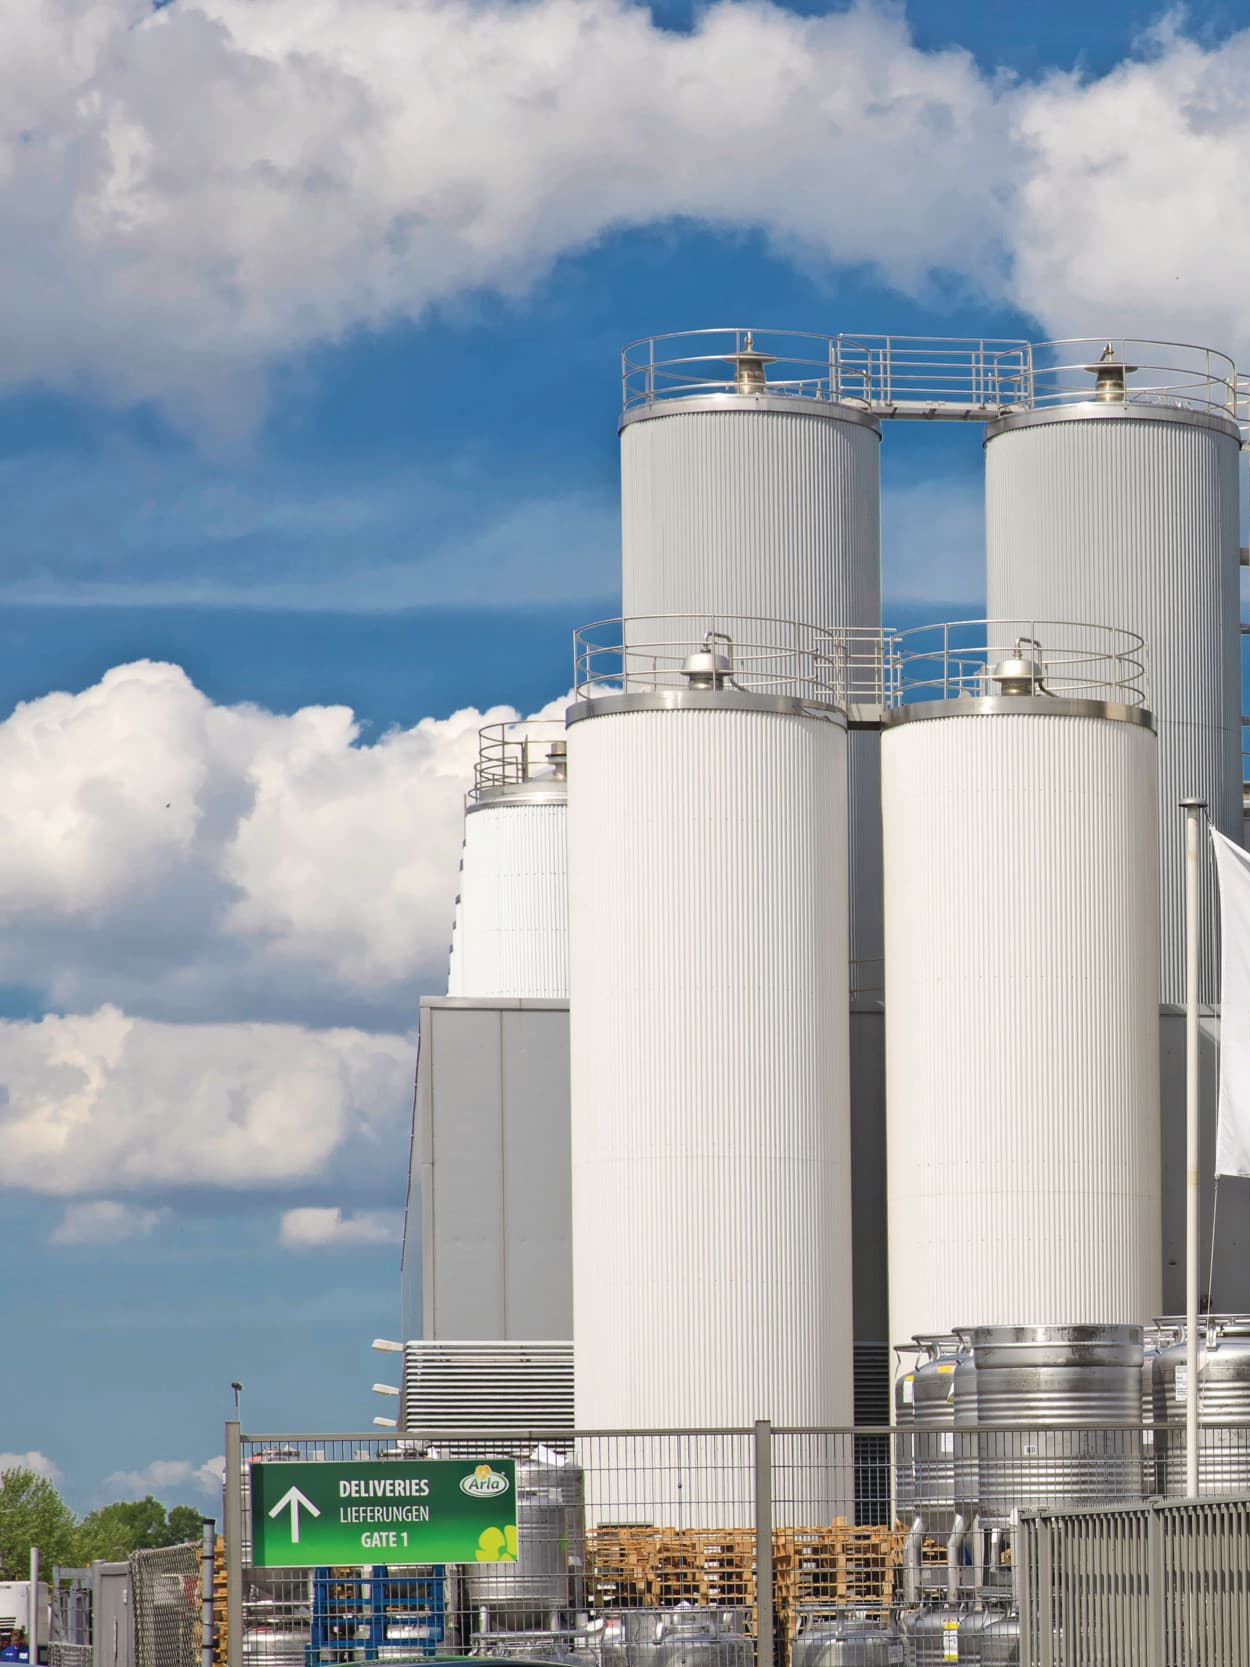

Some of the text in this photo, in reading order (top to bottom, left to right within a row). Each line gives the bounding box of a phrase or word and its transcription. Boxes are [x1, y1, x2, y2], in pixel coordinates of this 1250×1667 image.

[339, 1479, 430, 1498] DELIVERIES
[468, 1477, 500, 1490] Arla
[340, 1505, 430, 1523] LIEFERUNGEN
[361, 1531, 409, 1548] GATE 1
